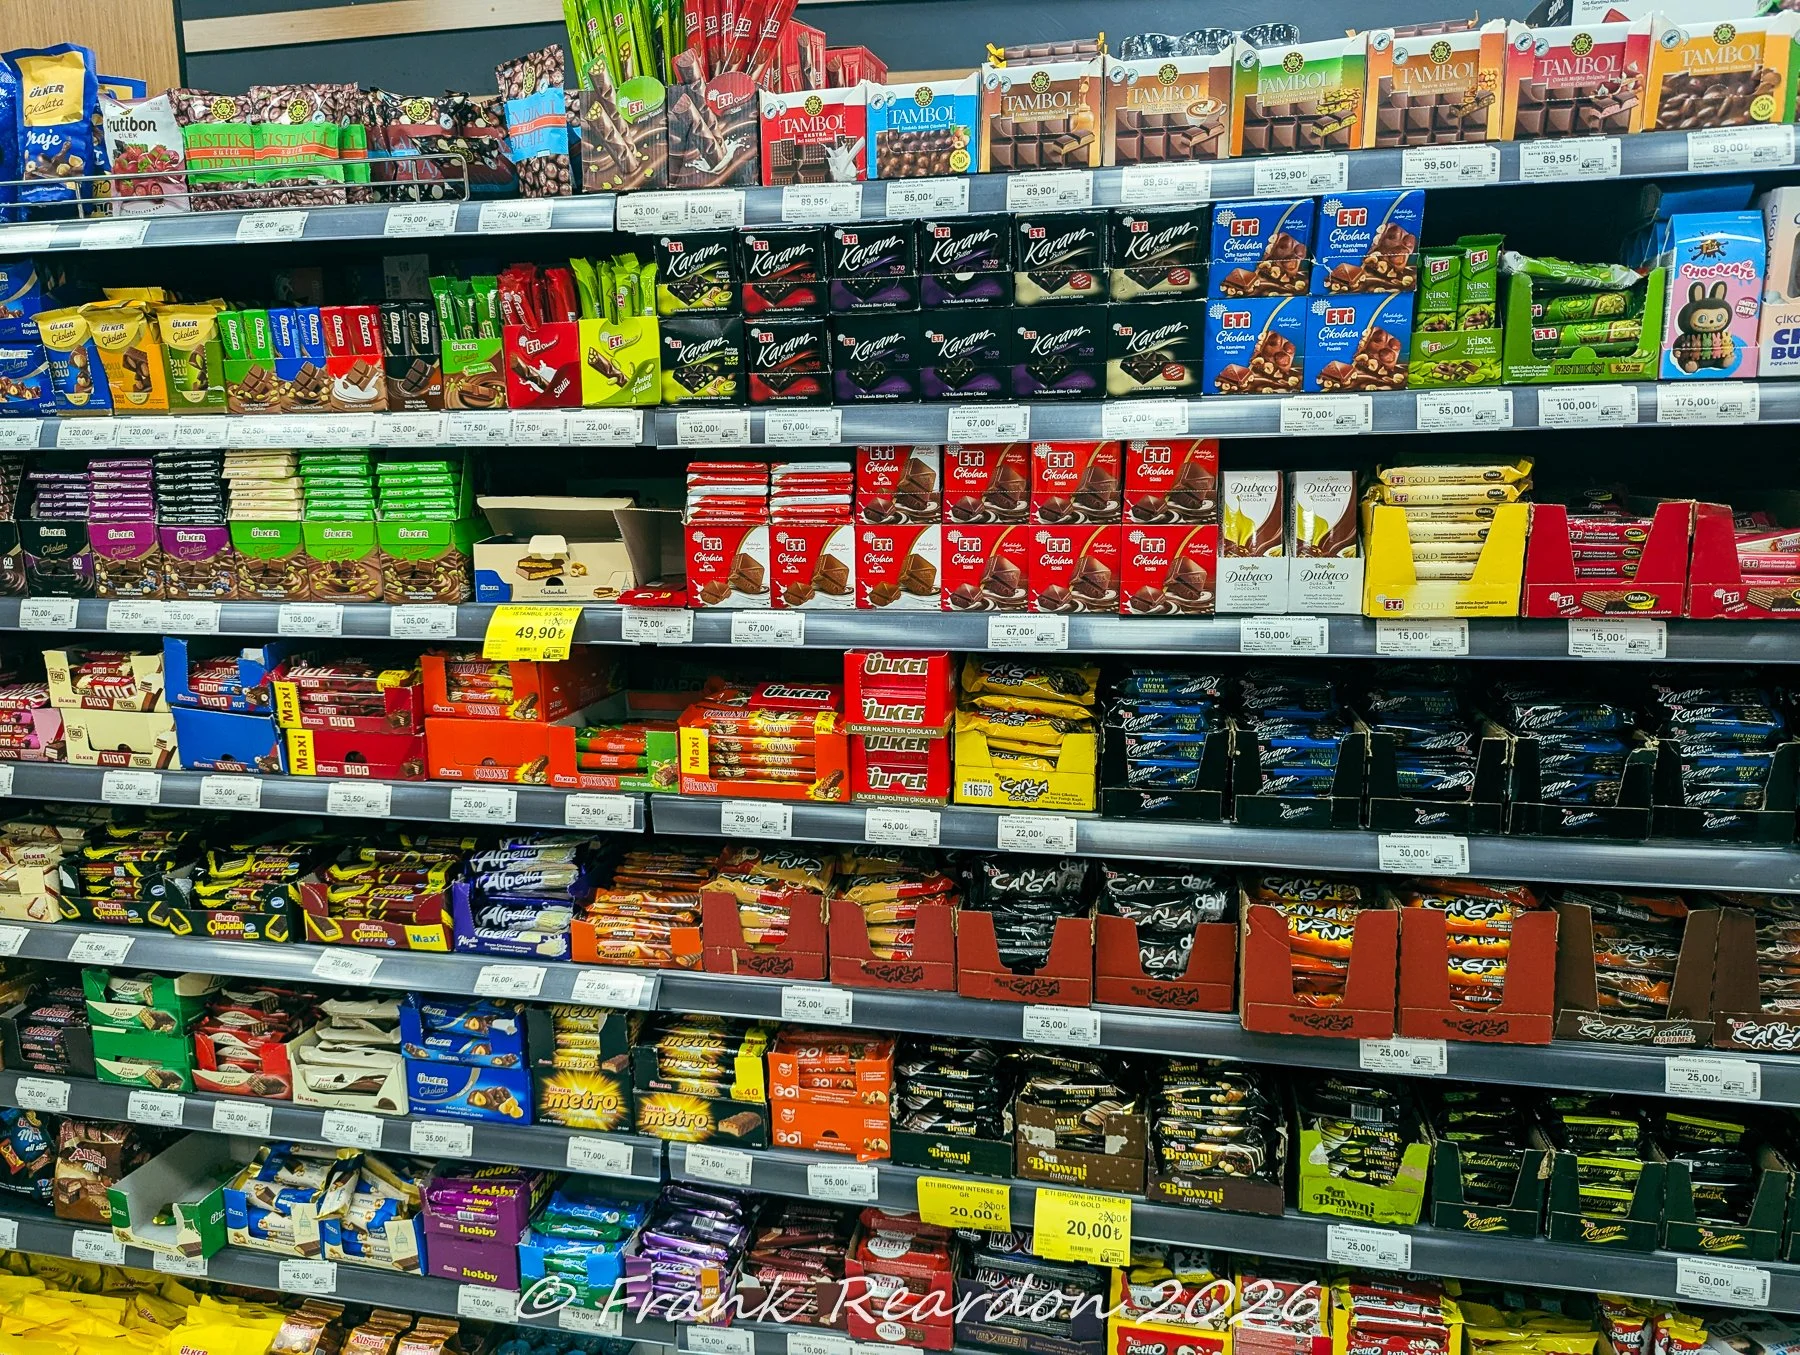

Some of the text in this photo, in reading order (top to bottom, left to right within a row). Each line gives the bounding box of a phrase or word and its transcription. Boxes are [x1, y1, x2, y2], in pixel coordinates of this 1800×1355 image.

[1681, 43, 1761, 66] TAMBOL
[1540, 55, 1621, 77] TAMBOL
[29, 82, 65, 98] ÜLKER
[1258, 70, 1333, 95] TAMBOL
[1004, 91, 1077, 111] TAMBOL
[1132, 84, 1200, 104] TAMBOL
[781, 115, 846, 134] TAMBOL
[890, 106, 954, 127] TAMBOL
[1124, 223, 1199, 260] Karam
[1223, 238, 1263, 252] Çikolata
[1329, 230, 1370, 244] Çikolata
[838, 236, 904, 271] Karam
[929, 228, 998, 264] Karam
[1024, 227, 1095, 264] Karam
[666, 241, 727, 277] Karam
[750, 244, 814, 276] Karam
[50, 321, 74, 330] ÜLKER
[100, 323, 125, 333] ÜLKER
[172, 319, 197, 329] ÜLKER
[309, 314, 319, 346] ÜLKER
[333, 314, 344, 347] ÜLKER
[359, 314, 373, 347] ÜLKER
[389, 312, 401, 344] ÜLKER
[418, 311, 430, 344] ÜLKER
[1032, 326, 1090, 356] Karam
[1126, 321, 1188, 352] Karam
[1216, 330, 1255, 344] Çikolata
[1318, 328, 1359, 342] Çikolata
[451, 341, 478, 351] ÜLKER
[677, 337, 729, 363] Karam
[755, 332, 818, 367] Karam
[850, 332, 907, 361] Karam
[939, 330, 997, 359] Karam
[1556, 400, 1598, 411] 100,00₺
[865, 462, 900, 475] Çikolata
[953, 466, 990, 480] Çikolata
[1041, 469, 1079, 482] Çikolata
[1137, 464, 1175, 478] Çikolata
[1230, 482, 1277, 496] Dubaco
[1302, 482, 1352, 496] Dubaco
[40, 526, 67, 539] ÜLKER
[108, 528, 135, 540] ÜLKER
[176, 531, 206, 543] ÜLKER
[251, 527, 280, 539] ÜLKER
[322, 527, 353, 540] ÜLKER
[398, 527, 429, 540] ÜLKER
[951, 553, 986, 565] Çikolata
[1040, 554, 1074, 566] Çikolata
[1132, 554, 1168, 567] Çikolata
[1225, 570, 1273, 584] Dubaco
[1299, 569, 1349, 583] Dubaco
[516, 626, 566, 641] 49,90₺
[762, 684, 830, 701] ÜLKER
[281, 687, 298, 722] Maxi
[294, 734, 308, 773] Maxi
[687, 736, 700, 770] Maxi
[968, 781, 994, 798] 16578
[1000, 780, 1048, 798] CANGA
[991, 868, 1058, 893] CANGA
[1181, 874, 1215, 889] dark
[1195, 894, 1228, 910] dark
[409, 932, 441, 944] Maxi
[417, 1073, 448, 1086] ÜLKER
[546, 1091, 618, 1110] metro
[643, 1111, 709, 1128] metro
[927, 1149, 971, 1164] Browni
[1163, 1148, 1213, 1164] Browni
[1028, 1157, 1088, 1178] Browni
[1159, 1183, 1224, 1204] Browni
[1312, 1192, 1376, 1214] Browni
[950, 1206, 1003, 1221] 20,00₺
[459, 1224, 497, 1238] hobby
[1066, 1220, 1123, 1240] 20,00₺
[462, 1267, 498, 1282] hobby
